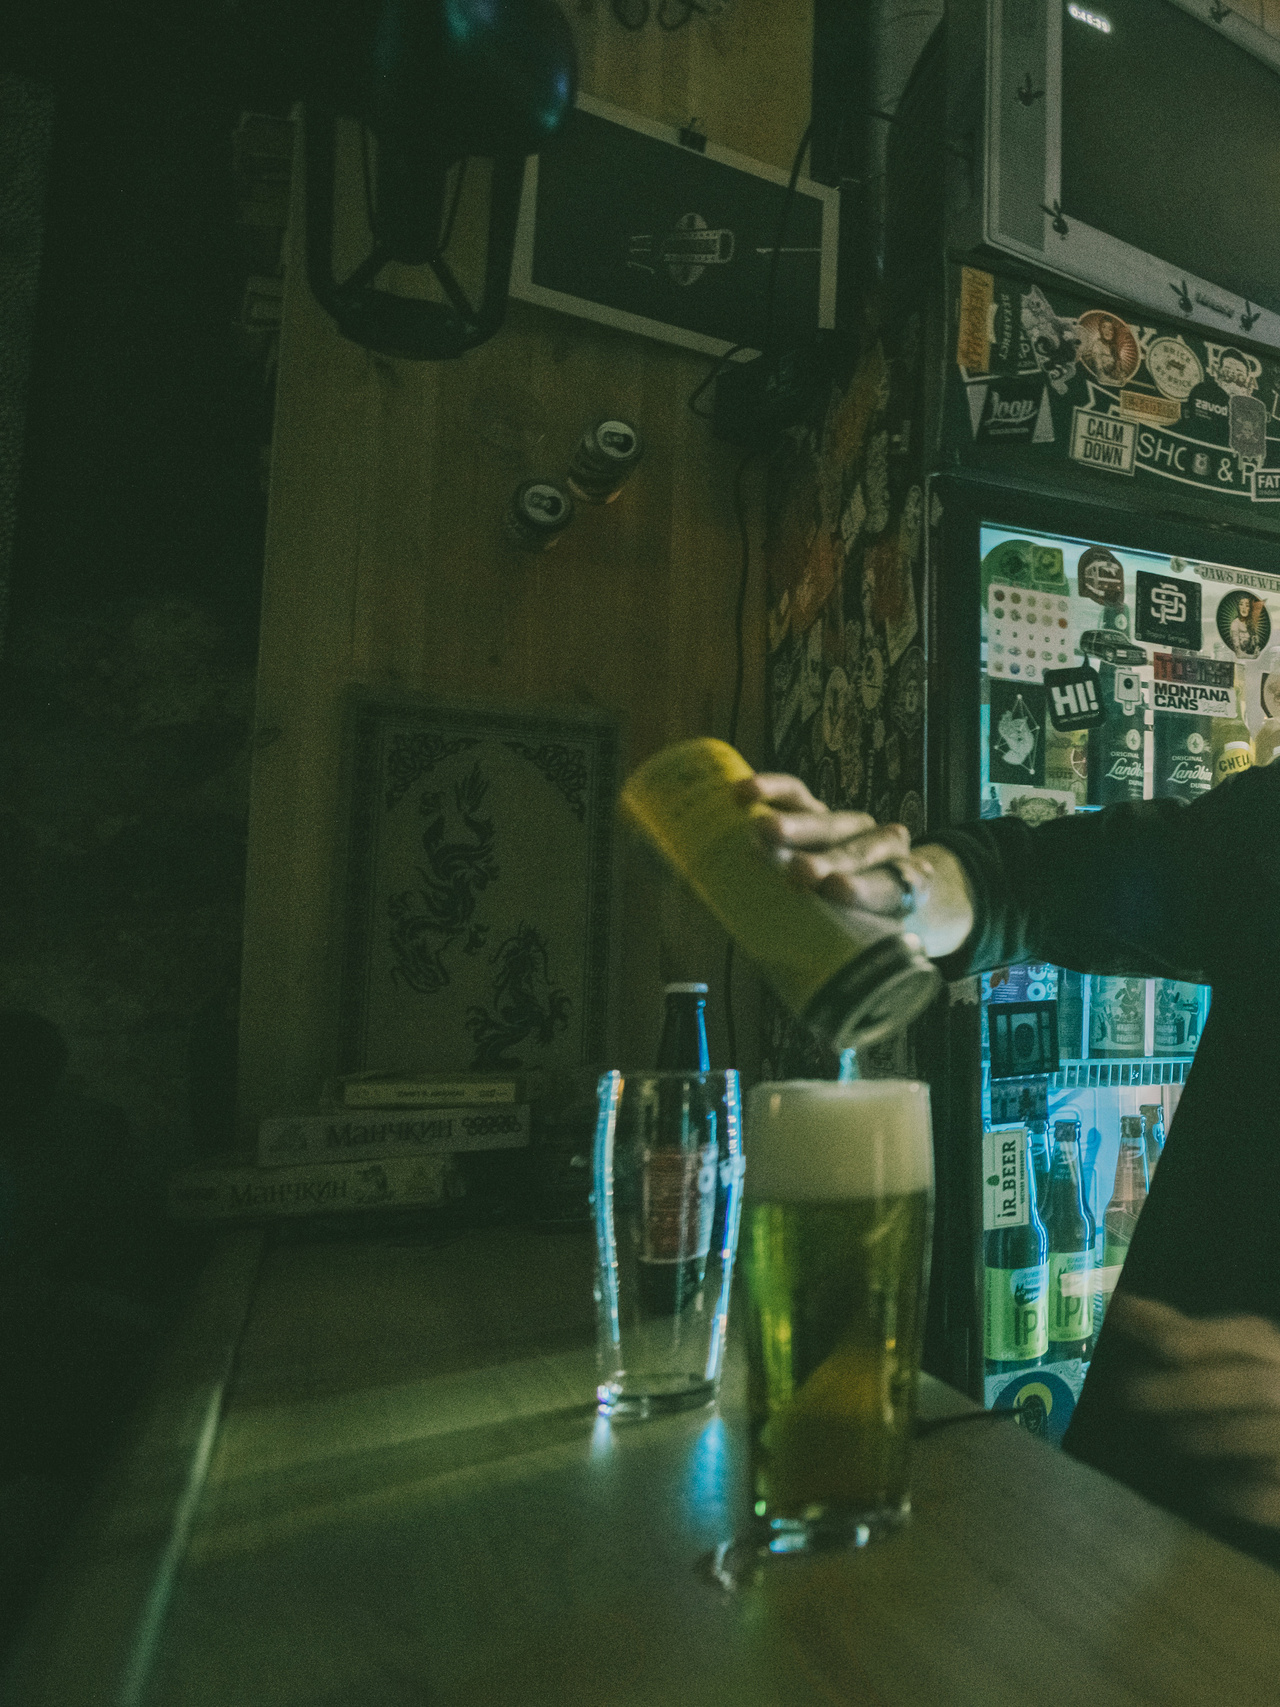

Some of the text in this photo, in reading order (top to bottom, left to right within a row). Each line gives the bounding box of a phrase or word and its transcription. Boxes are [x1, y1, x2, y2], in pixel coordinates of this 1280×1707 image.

[1195, 399, 1229, 416] zavod
[1087, 417, 1124, 443] CALM
[1083, 440, 1123, 466] DOWN
[1257, 474, 1280, 488] FAT
[1201, 566, 1234, 584] JAWS
[1051, 680, 1100, 716] HI!
[1154, 682, 1231, 703] MONTANA
[1154, 695, 1199, 711] CANS
[325, 1117, 454, 1148] Манчкин
[1056, 1290, 1092, 1328] IPA
[1014, 1307, 1048, 1346] IPA
